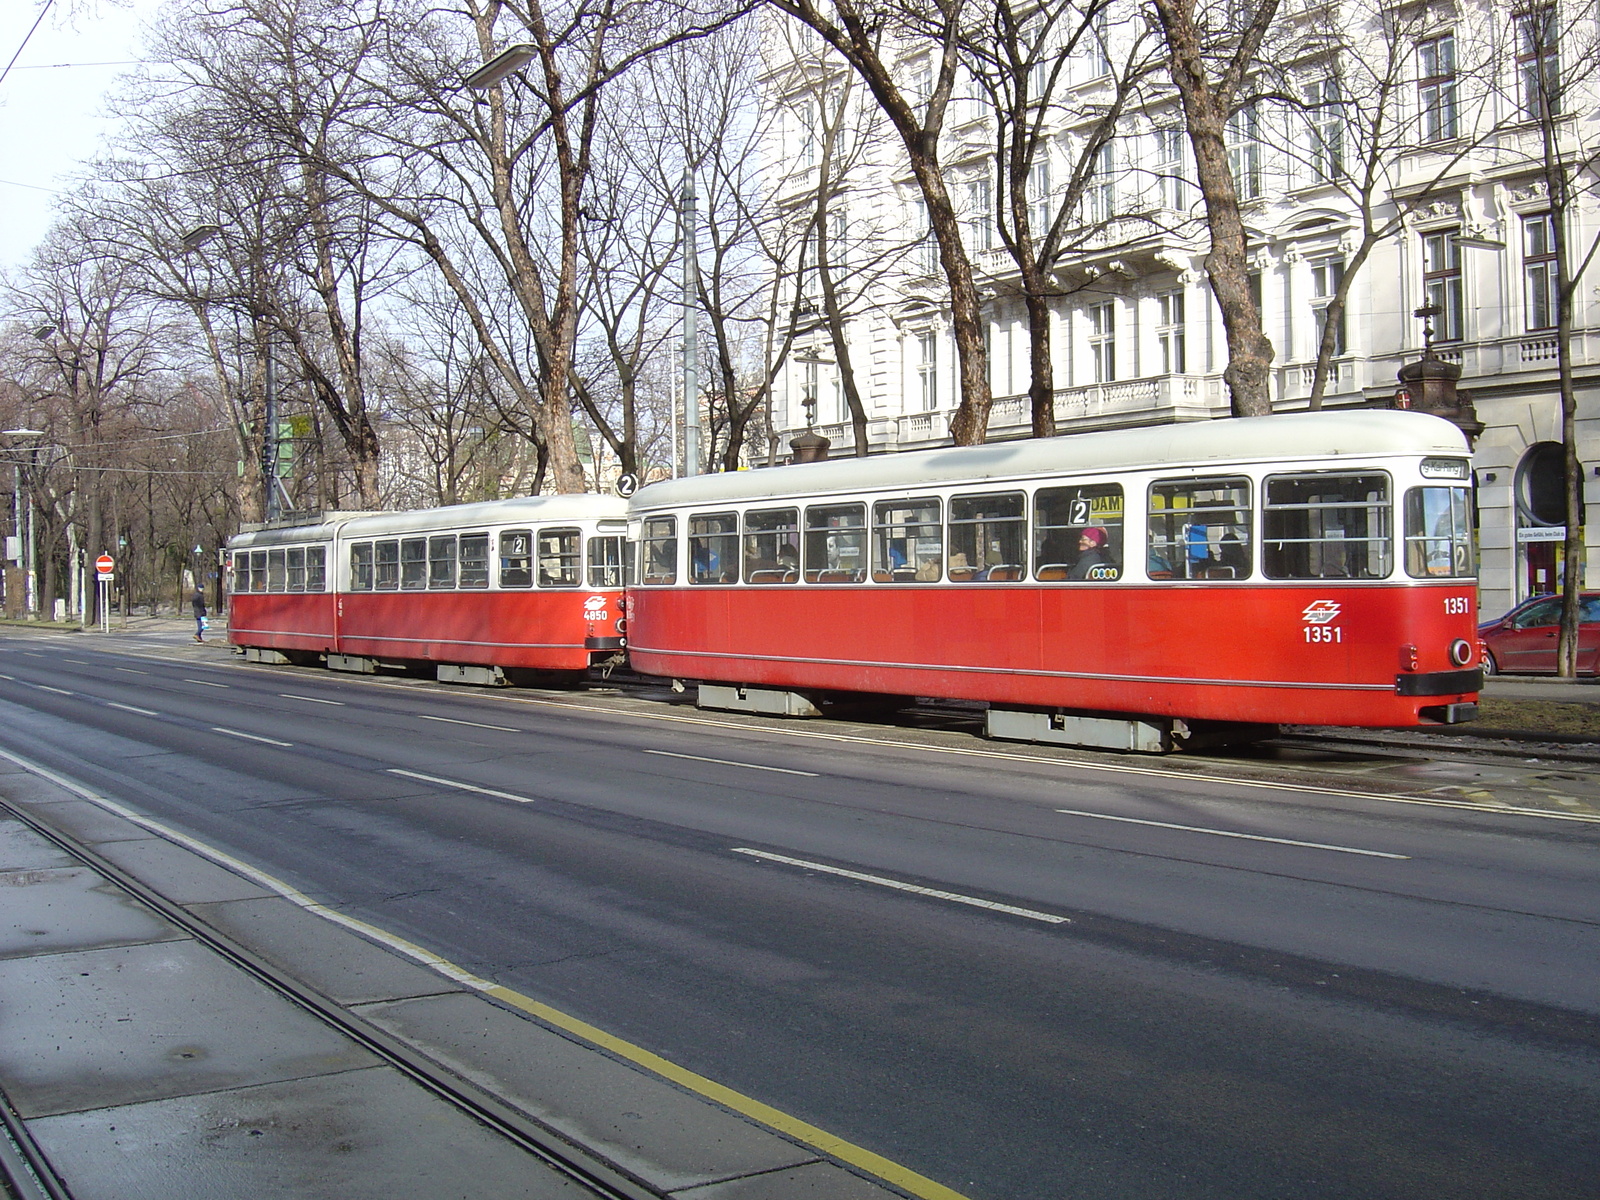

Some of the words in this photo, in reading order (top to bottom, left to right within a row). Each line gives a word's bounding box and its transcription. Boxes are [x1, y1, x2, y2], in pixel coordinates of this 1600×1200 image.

[621, 475, 632, 494] 2
[1073, 501, 1087, 524] 2
[515, 539, 523, 553] 2
[1456, 545, 1465, 571] 2
[1443, 597, 1469, 614] 1351
[583, 610, 608, 621] 4850
[1303, 626, 1341, 643] 1351
